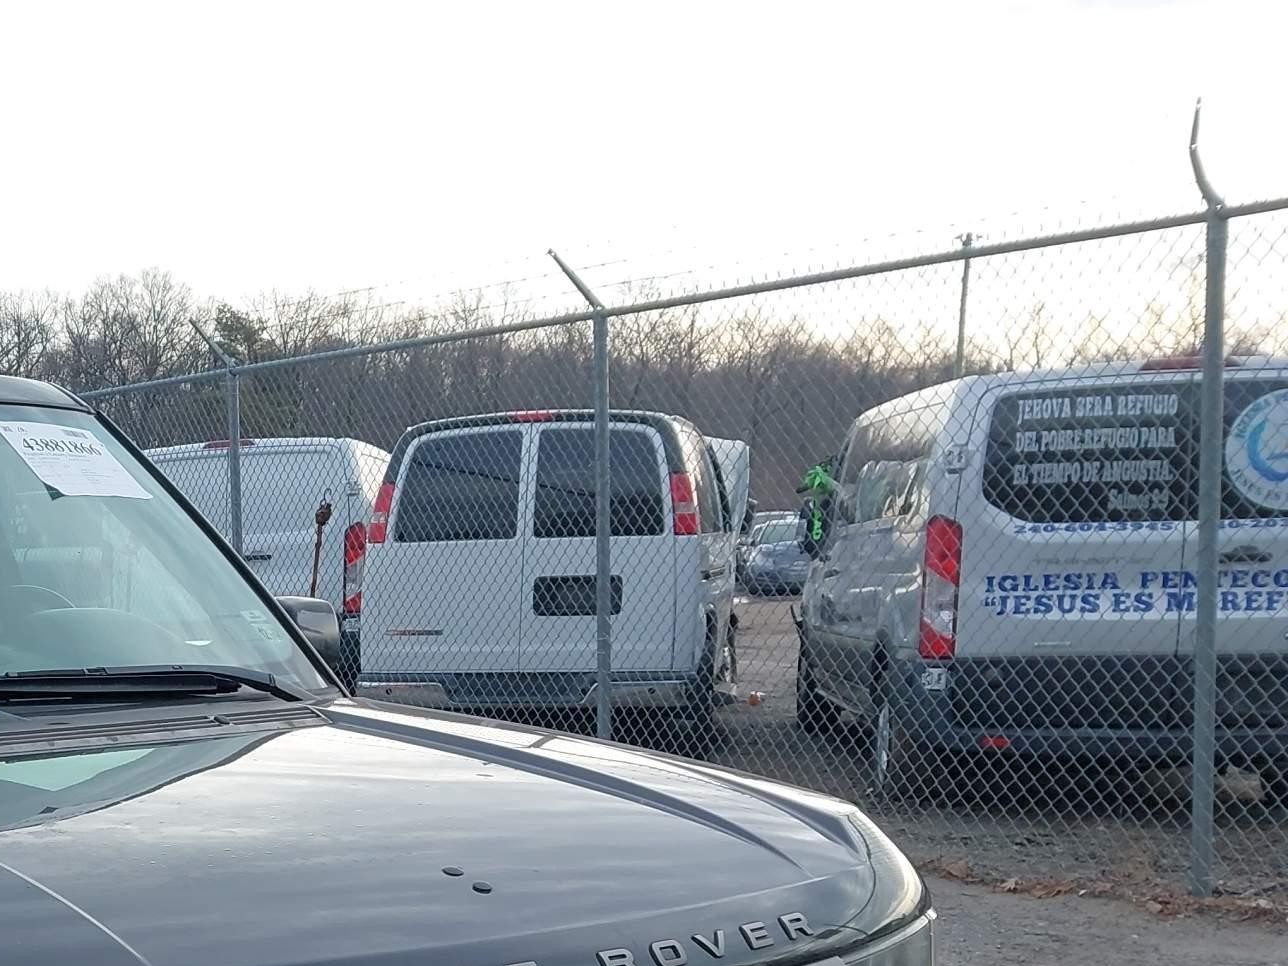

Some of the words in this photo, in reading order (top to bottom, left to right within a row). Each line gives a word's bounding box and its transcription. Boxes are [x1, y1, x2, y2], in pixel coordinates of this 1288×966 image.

[1018, 398, 1071, 424] JEHOVA
[1076, 396, 1113, 416] SERA
[1117, 394, 1178, 416] REFUGIO
[23, 438, 103, 456] 43881866
[1016, 431, 1039, 452] DEL
[1140, 427, 1177, 449] PARA
[985, 571, 1120, 593] IGLESIA
[1112, 591, 1154, 613] ES
[1165, 591, 1195, 612] M
[1220, 590, 1288, 612] REF
